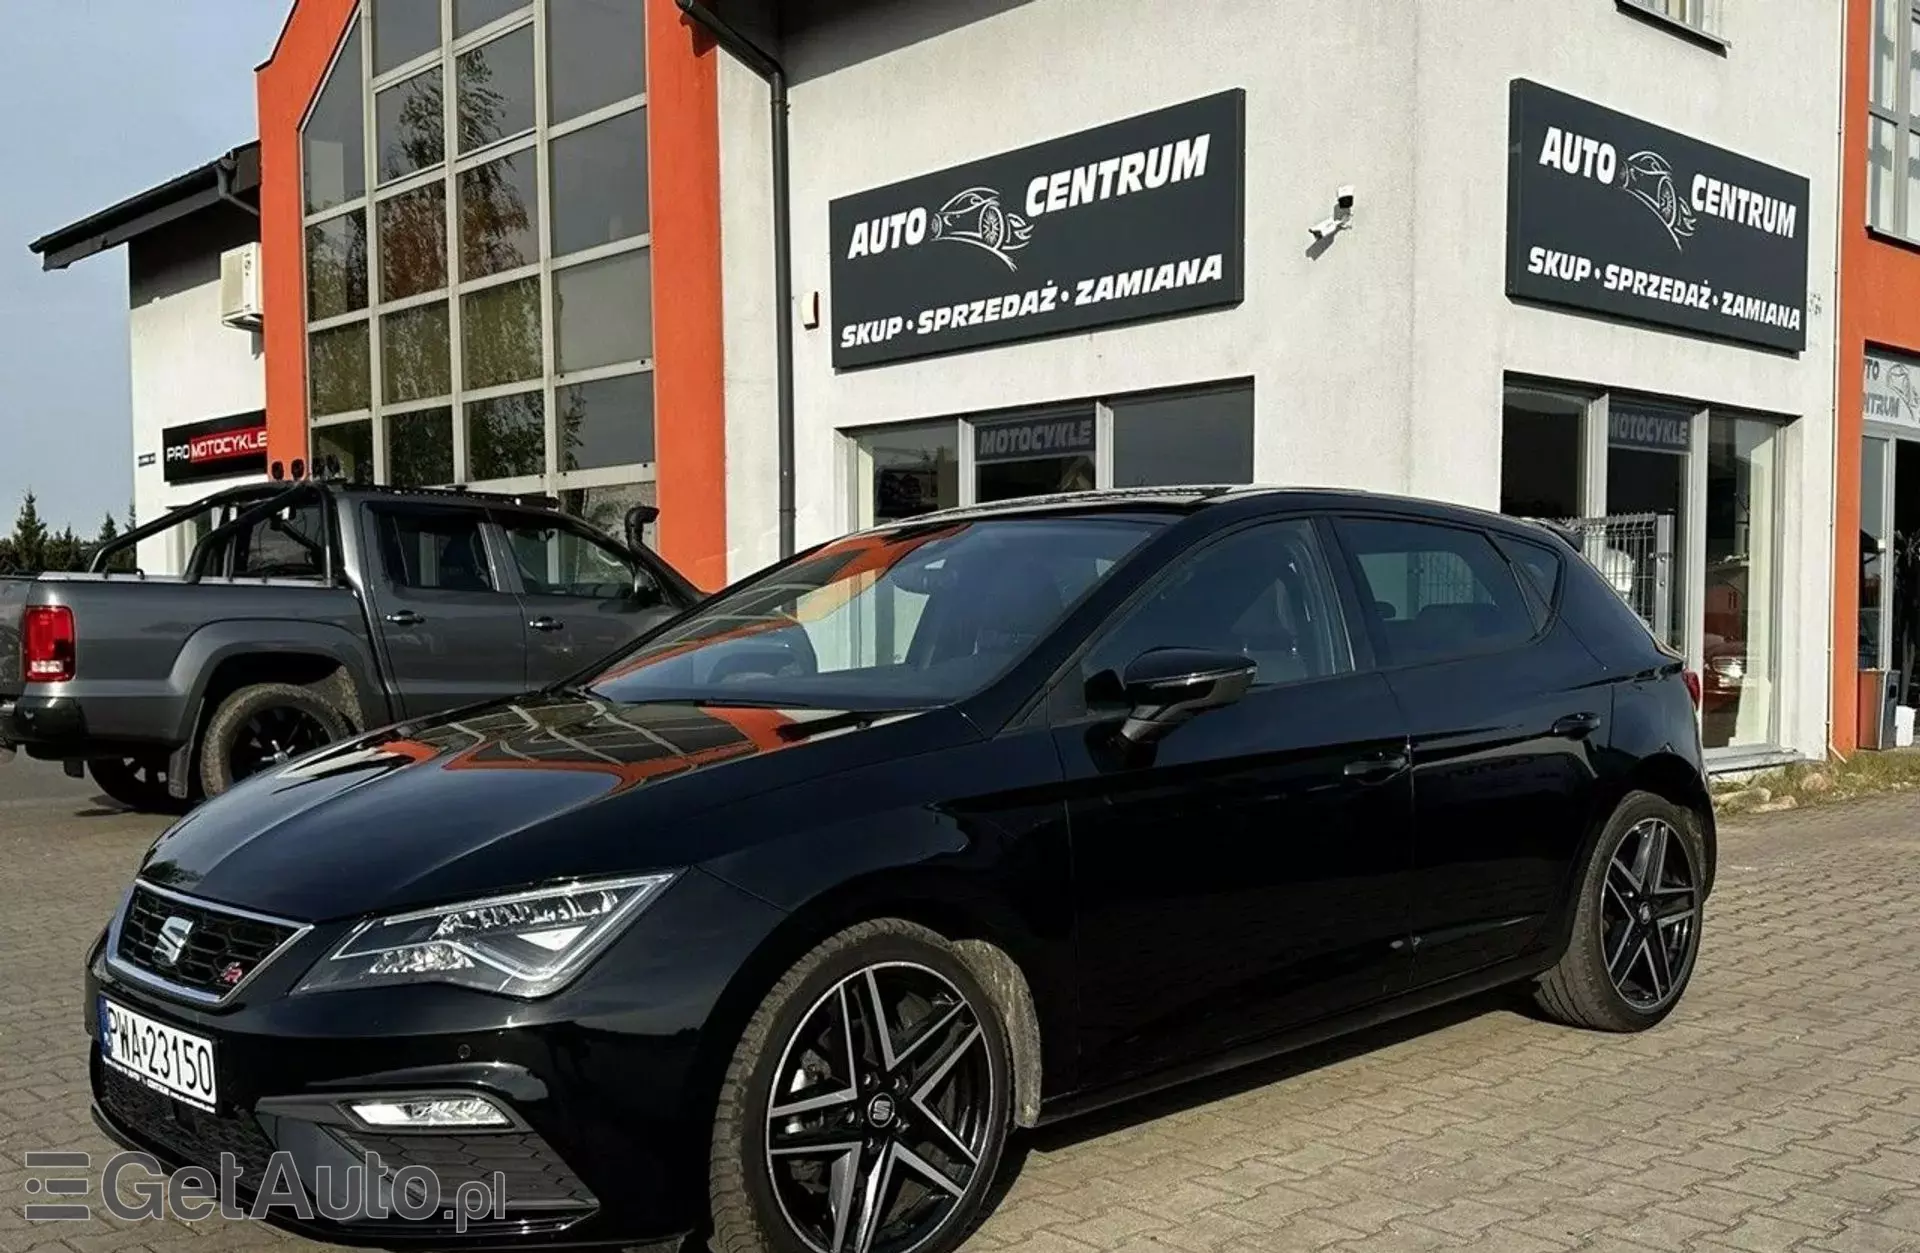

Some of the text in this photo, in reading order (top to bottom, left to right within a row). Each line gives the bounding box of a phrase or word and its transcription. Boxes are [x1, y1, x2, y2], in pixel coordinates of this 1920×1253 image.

[847, 134, 1211, 260] AUTO CENTRUM
[1539, 126, 1797, 238] AUTO CENTRUM
[840, 254, 1223, 349] SKUP SPRZEDAŻ ZAMIANA
[1527, 246, 1801, 331] SKUP SPRZEDAŻ ZAMIANA
[978, 419, 1093, 454] MOTOCYKLE
